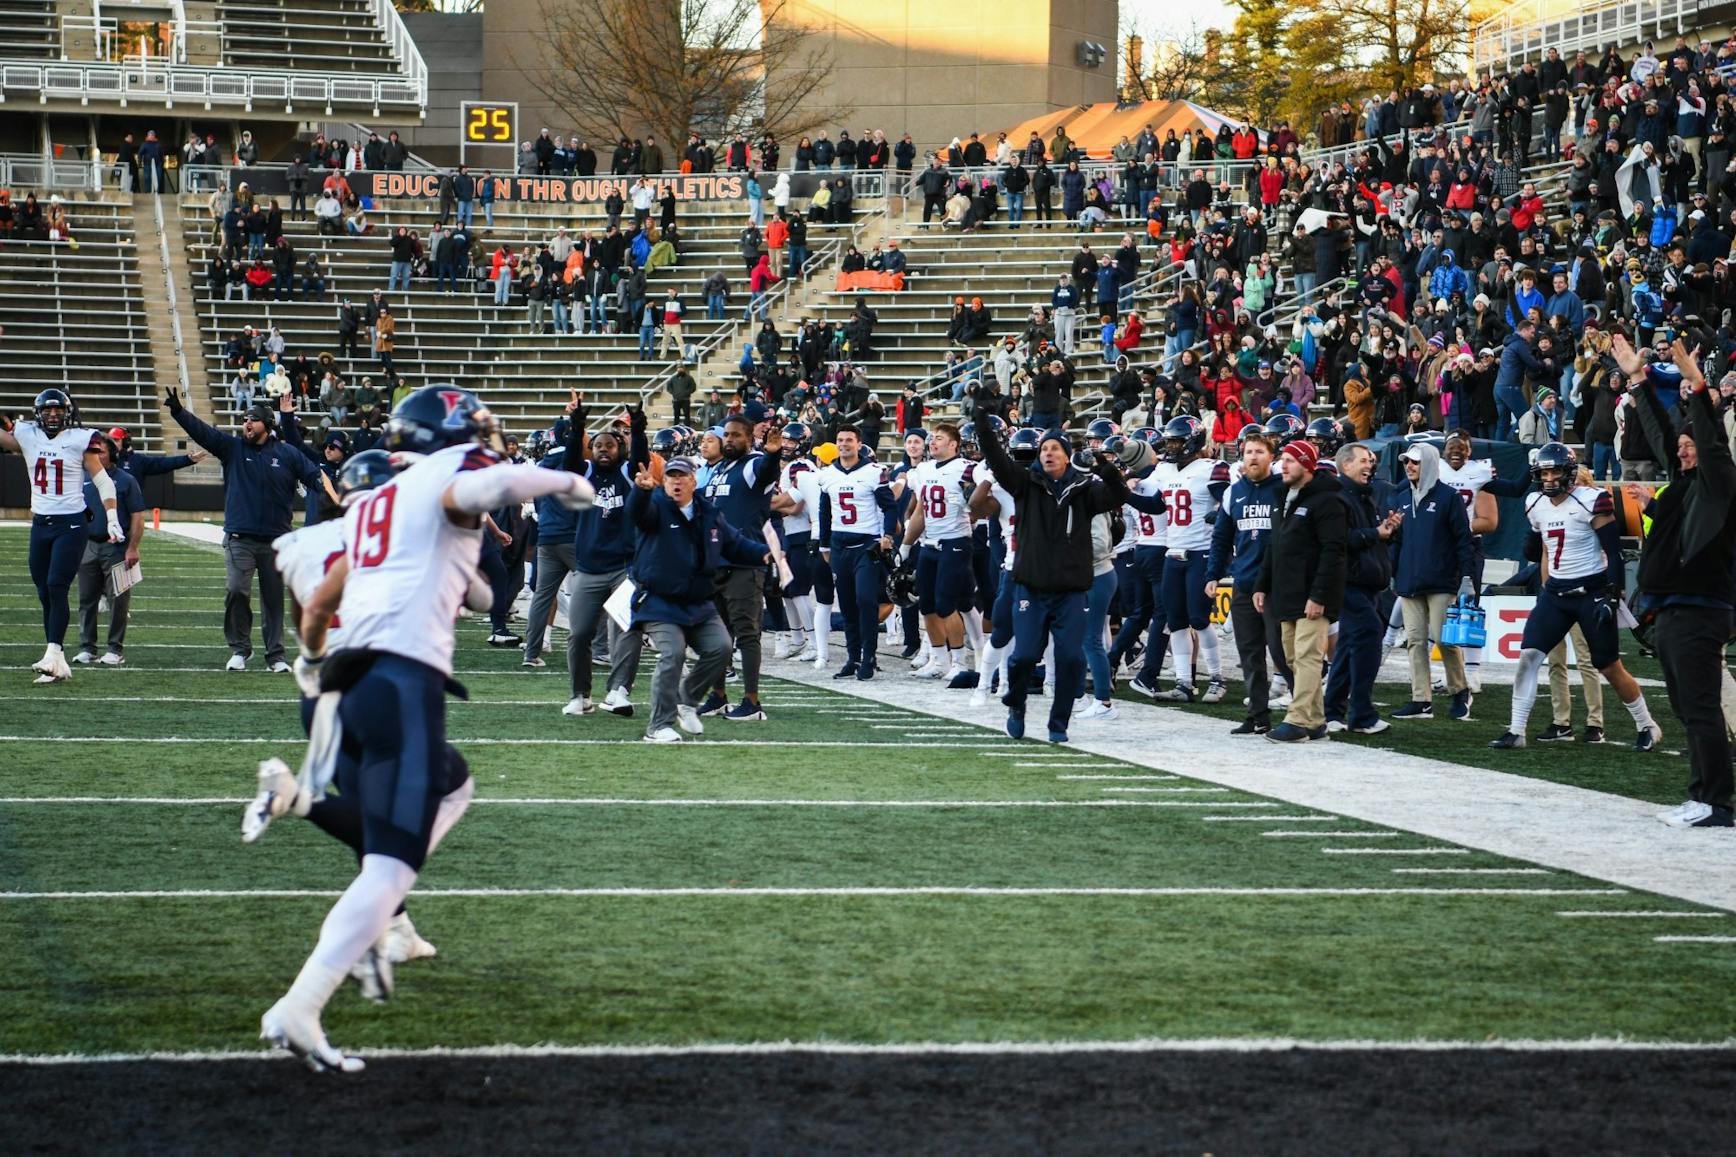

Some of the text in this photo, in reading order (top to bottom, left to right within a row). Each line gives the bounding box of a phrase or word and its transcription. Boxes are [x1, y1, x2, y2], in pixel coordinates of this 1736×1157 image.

[469, 109, 510, 140] 25
[645, 176, 743, 200] THLETICS
[34, 457, 64, 496] 41
[838, 492, 858, 526] 5
[920, 484, 947, 519] 48
[1162, 489, 1193, 527] 58
[1242, 504, 1271, 518] PENN
[353, 483, 399, 569] 19
[1238, 518, 1271, 530] FOOTBAL
[1547, 528, 1566, 570] 7
